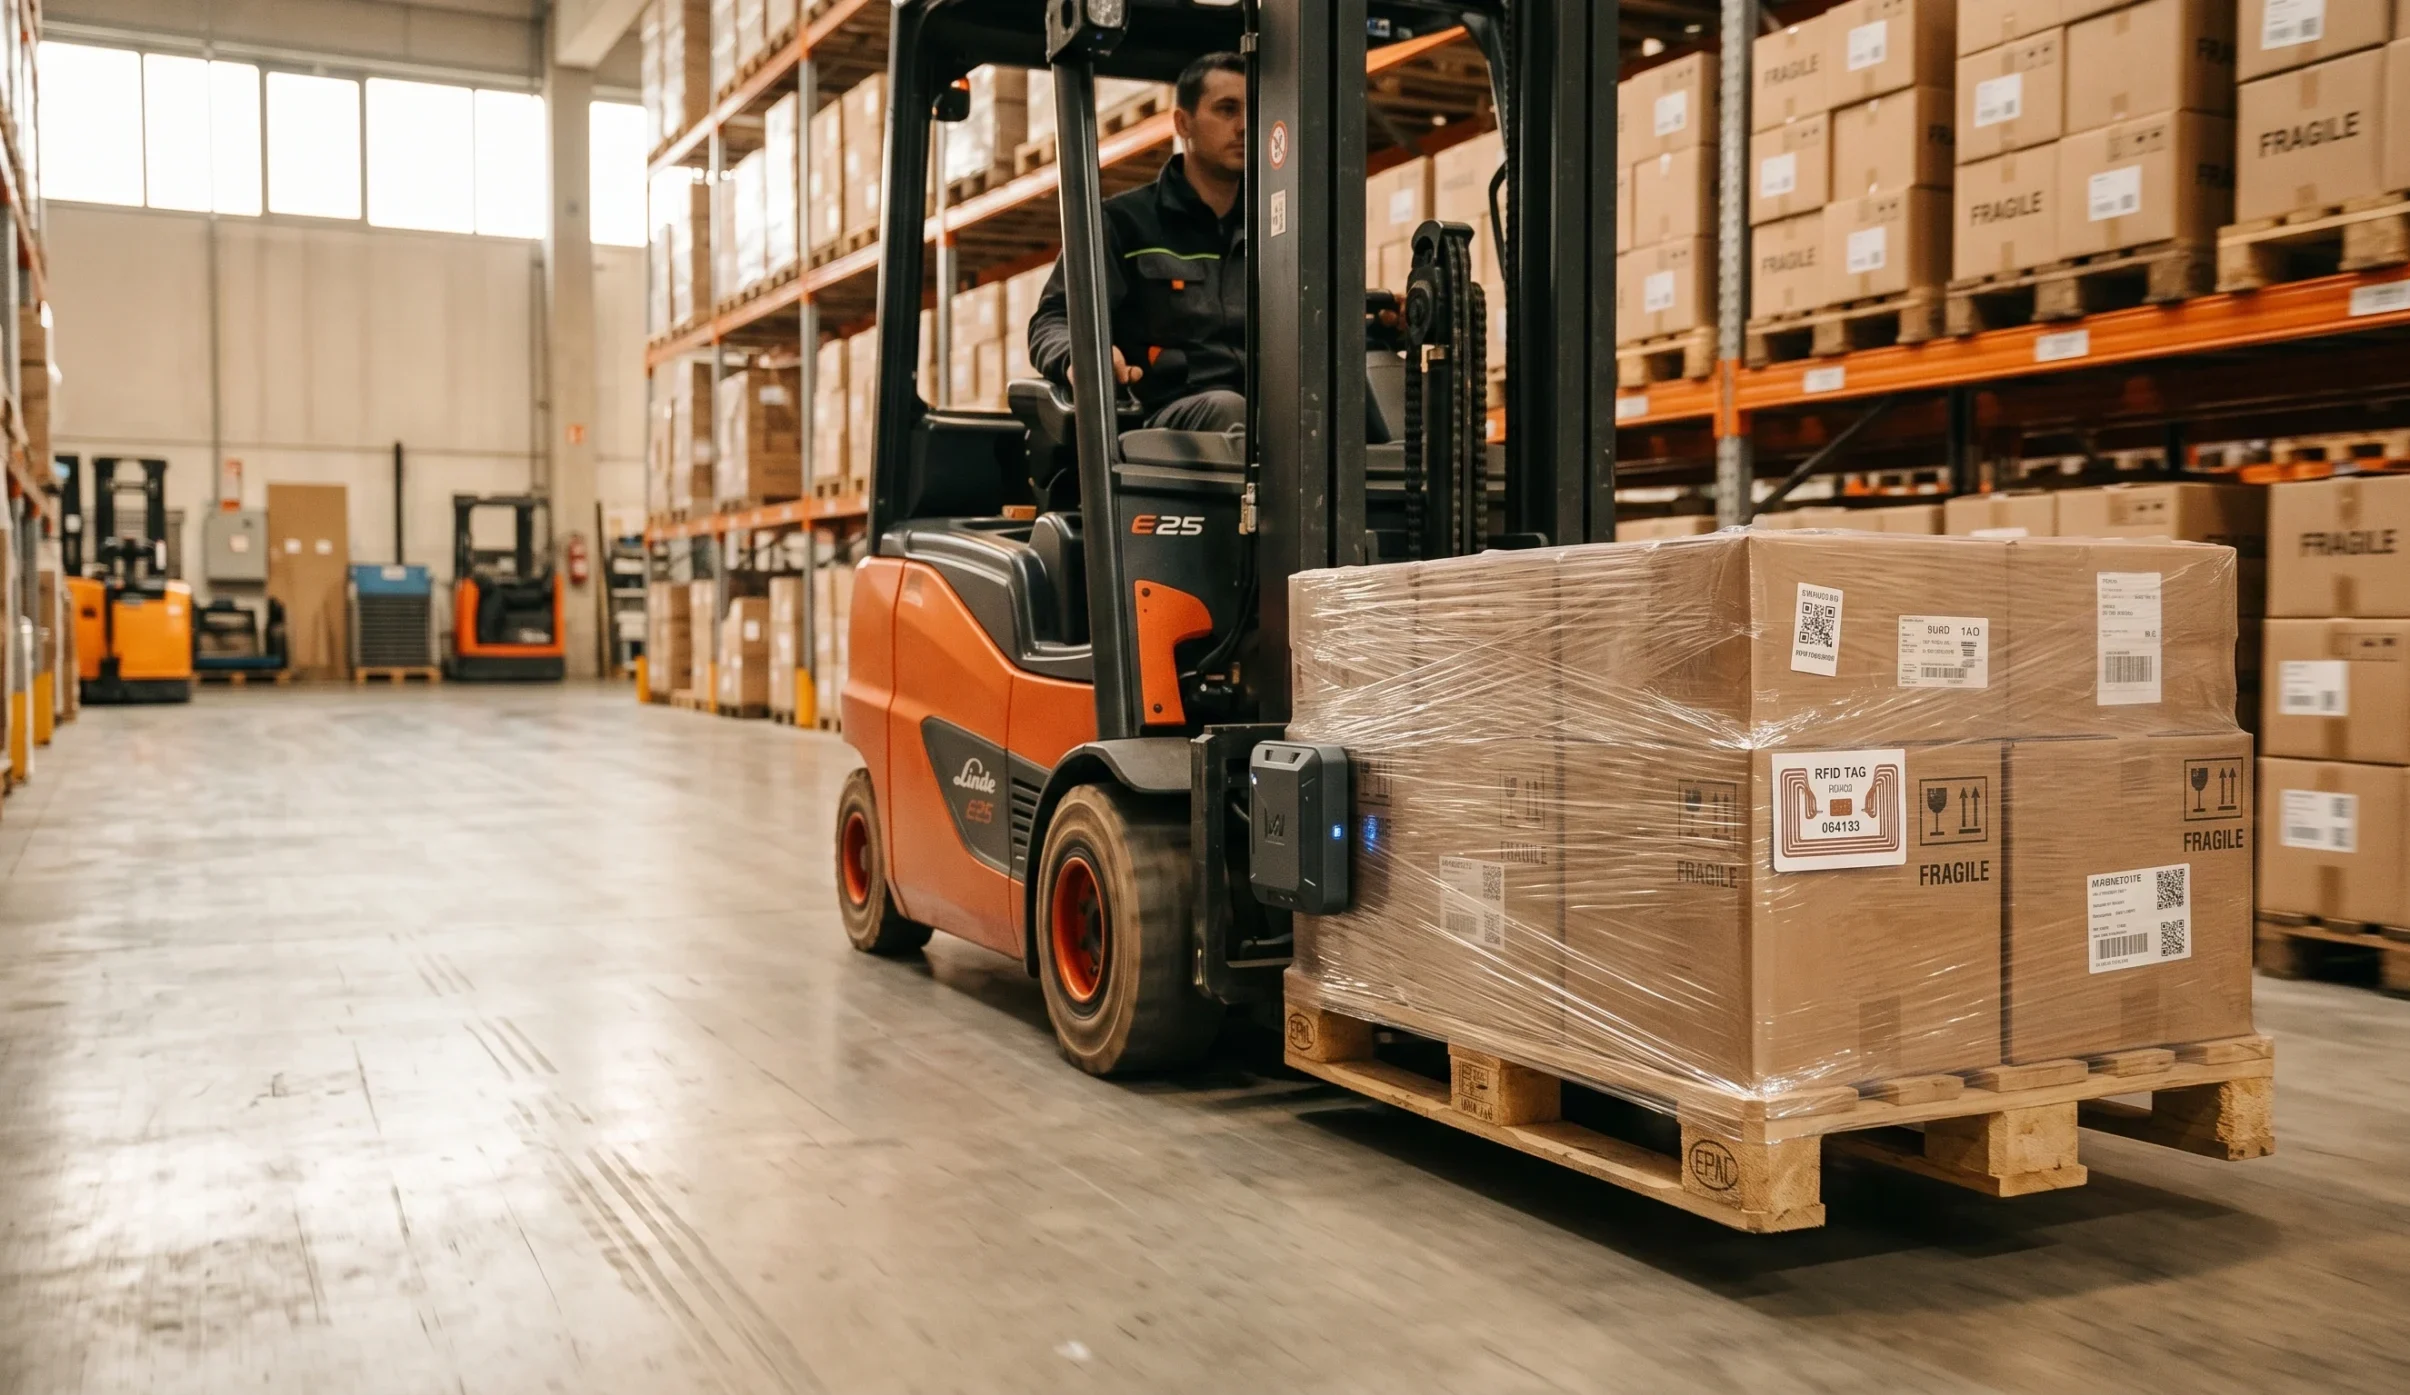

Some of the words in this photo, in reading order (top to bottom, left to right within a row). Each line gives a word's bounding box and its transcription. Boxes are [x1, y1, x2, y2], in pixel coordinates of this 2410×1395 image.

[1763, 52, 1820, 89] FRAGILE
[2259, 110, 2361, 159] FRAGILE
[1969, 190, 2043, 227] FRAGILE
[1131, 514, 1206, 536] E25
[2299, 528, 2397, 557] FRAGILE
[953, 757, 996, 794] Linde
[1815, 767, 1840, 779] RFID
[1844, 766, 1866, 778] TAG
[1822, 820, 1860, 833] 064133
[2184, 829, 2244, 852] FRAGILE
[1676, 860, 1738, 889] FRAGILE
[1920, 860, 1989, 886] FRAGILE
